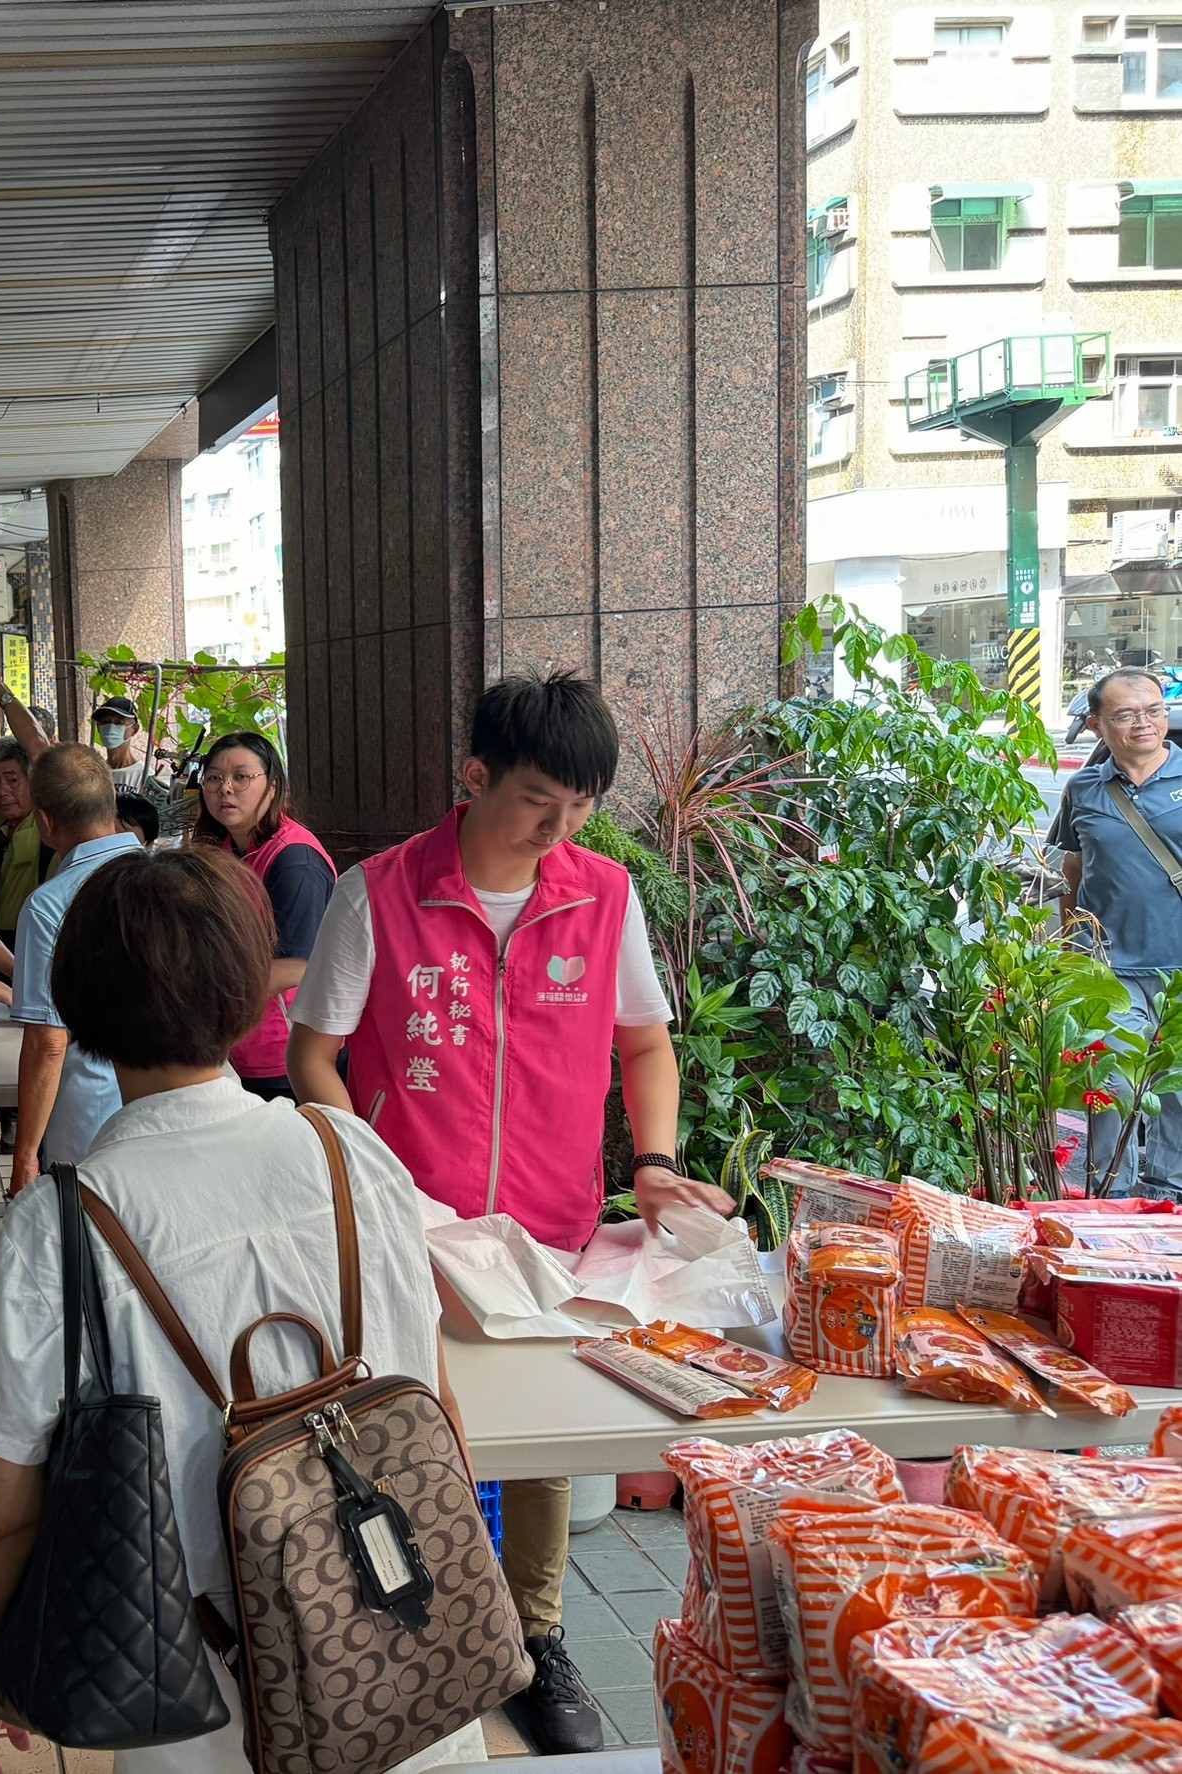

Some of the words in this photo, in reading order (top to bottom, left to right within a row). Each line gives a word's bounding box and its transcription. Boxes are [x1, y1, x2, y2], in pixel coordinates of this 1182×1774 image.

[406, 963, 445, 1092] 何純瑩
[449, 951, 472, 1046] 執行秘書
